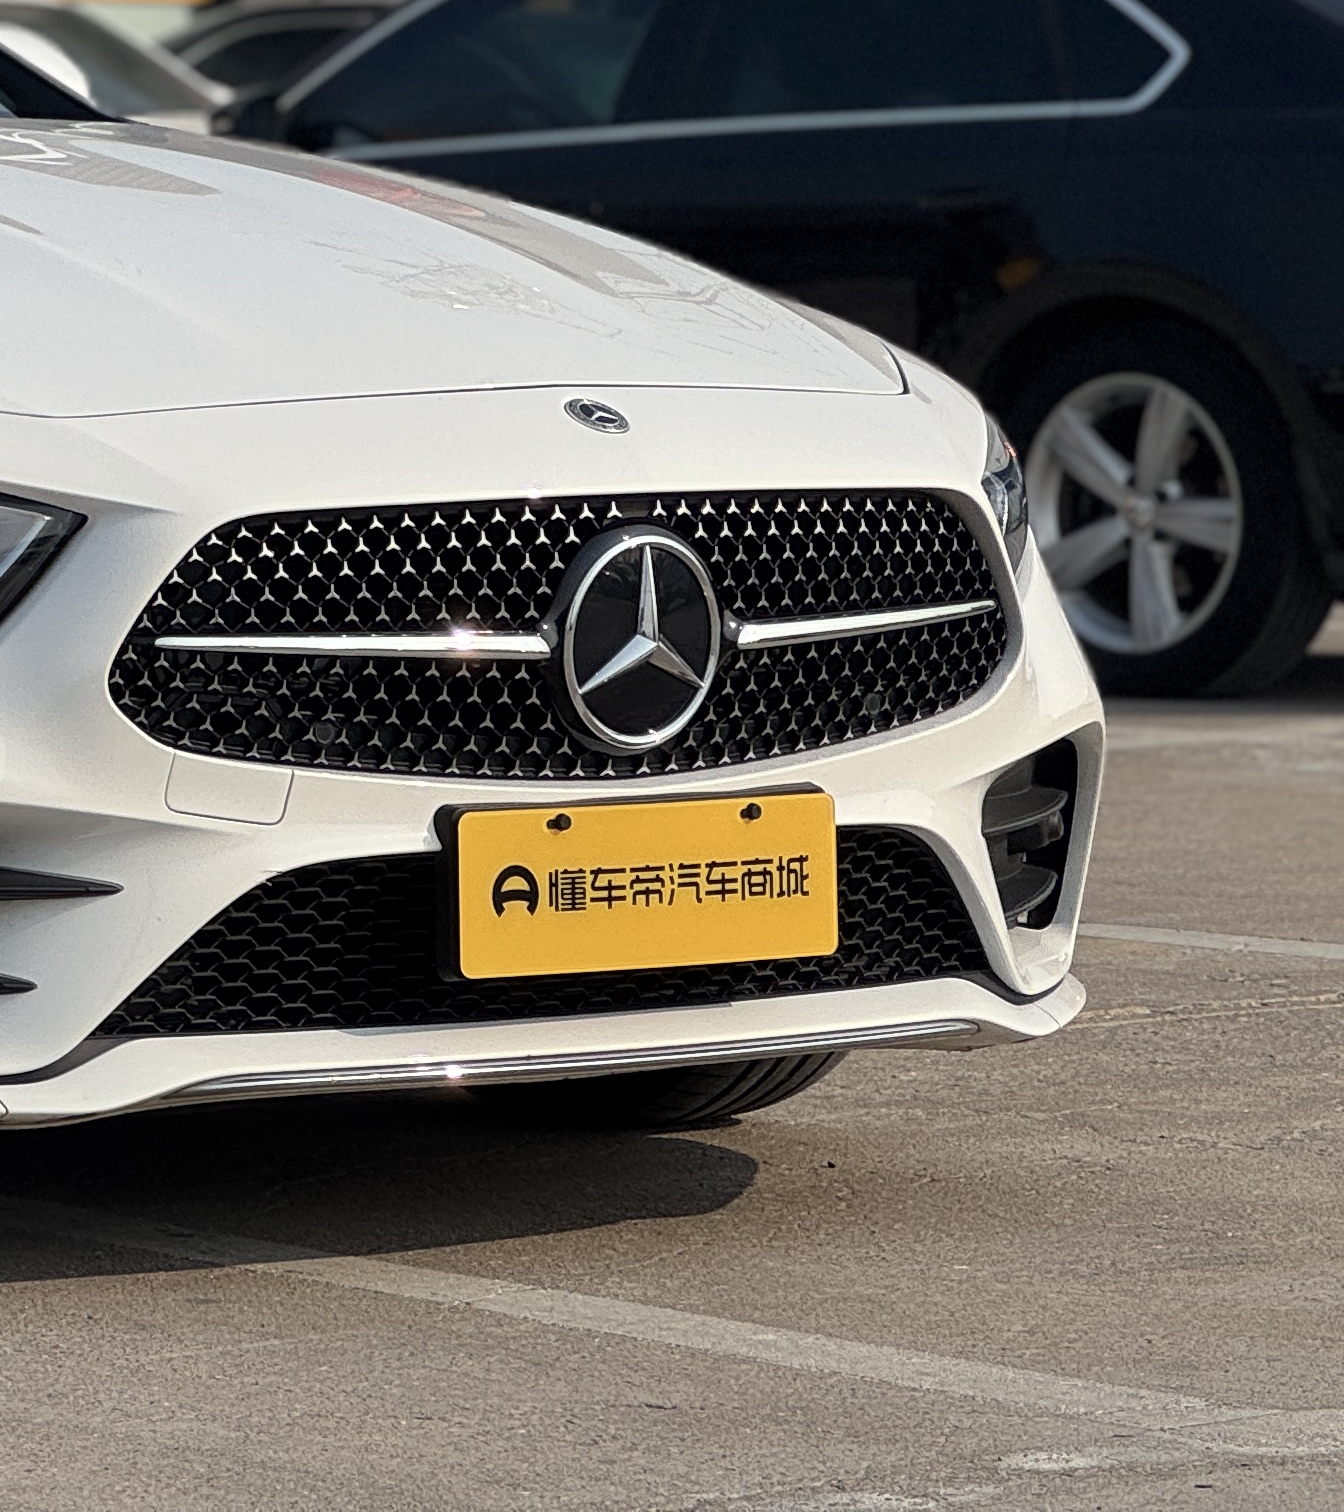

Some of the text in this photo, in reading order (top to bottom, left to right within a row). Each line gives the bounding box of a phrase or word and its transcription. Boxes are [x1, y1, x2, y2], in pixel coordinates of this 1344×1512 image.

[549, 855, 809, 911] 懂车帝汽车商城
